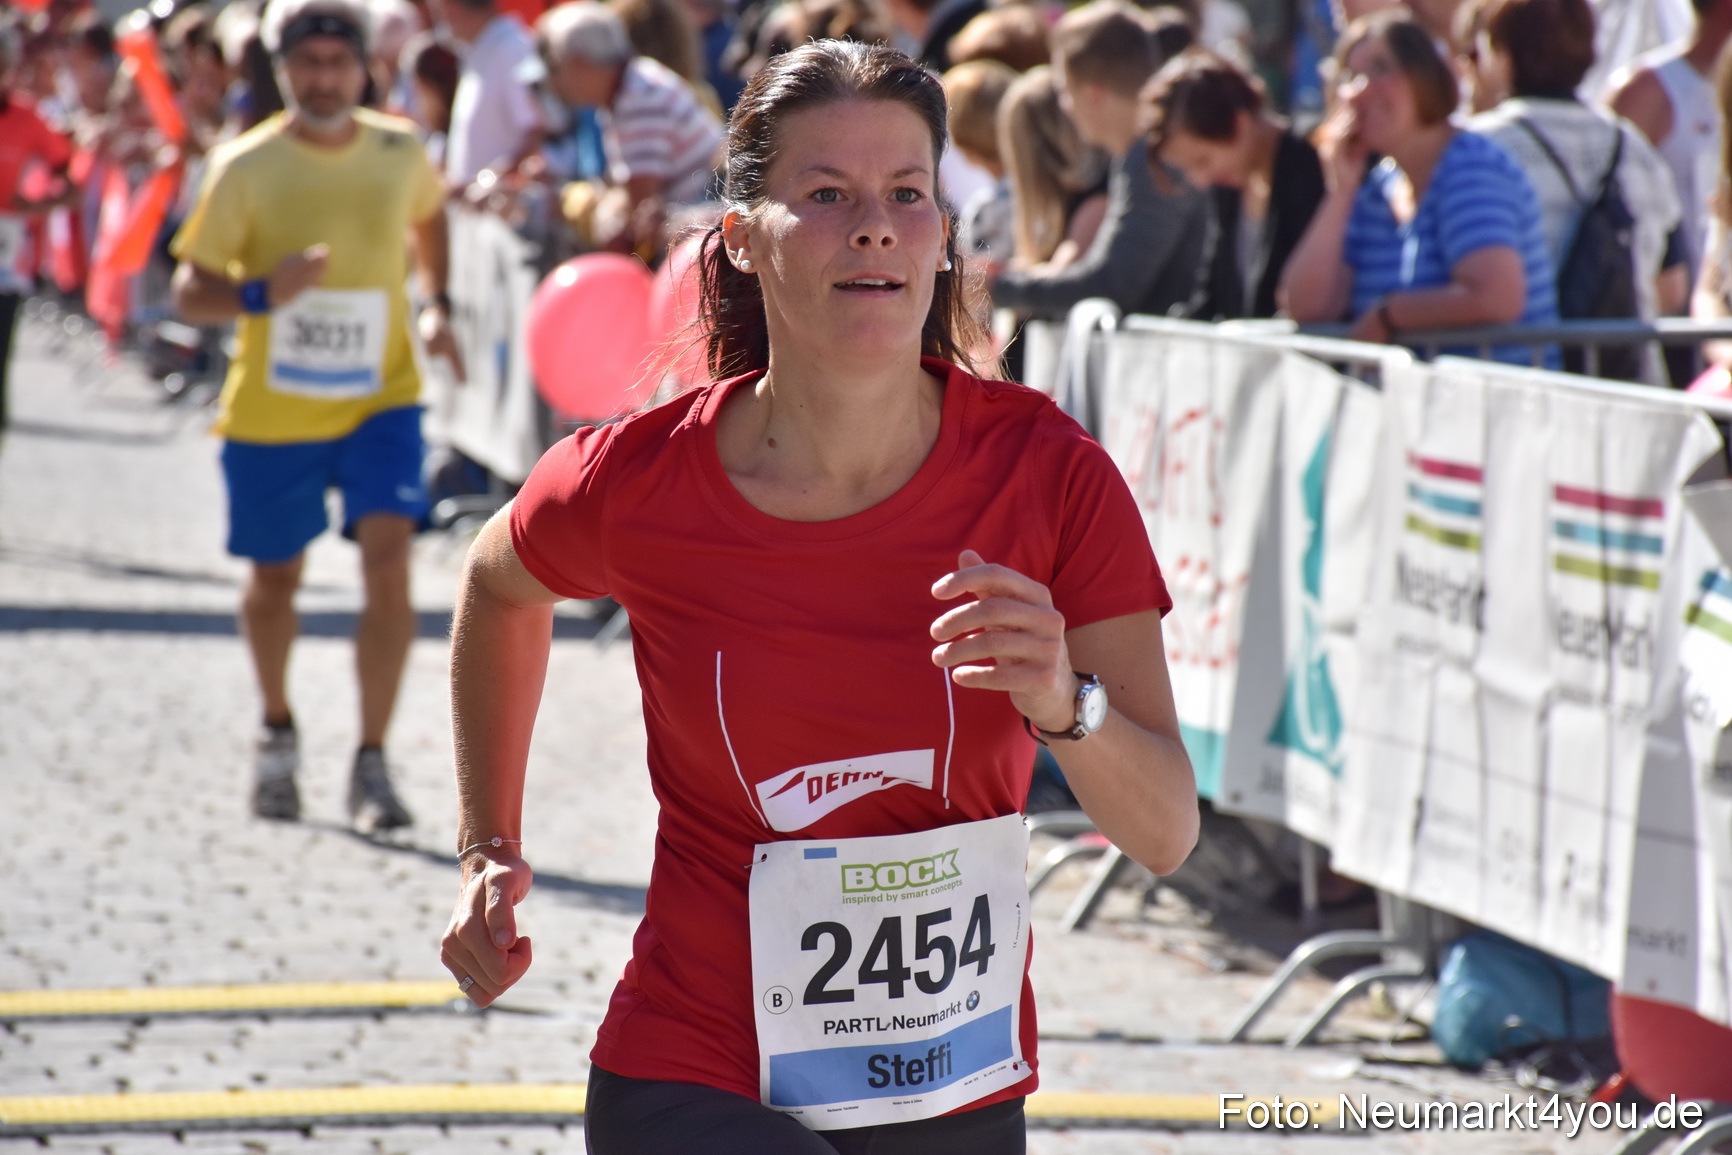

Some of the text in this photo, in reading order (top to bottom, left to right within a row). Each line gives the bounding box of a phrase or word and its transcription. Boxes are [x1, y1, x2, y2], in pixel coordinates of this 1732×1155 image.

[807, 770, 884, 804] DEHN
[841, 848, 961, 893] BOCK
[842, 879, 963, 905] inspired by smart concepts
[801, 893, 996, 1006] 2454
[772, 993, 783, 1008] B
[892, 1000, 962, 1030] Neumarkt
[867, 1041, 953, 1089] Steffi
